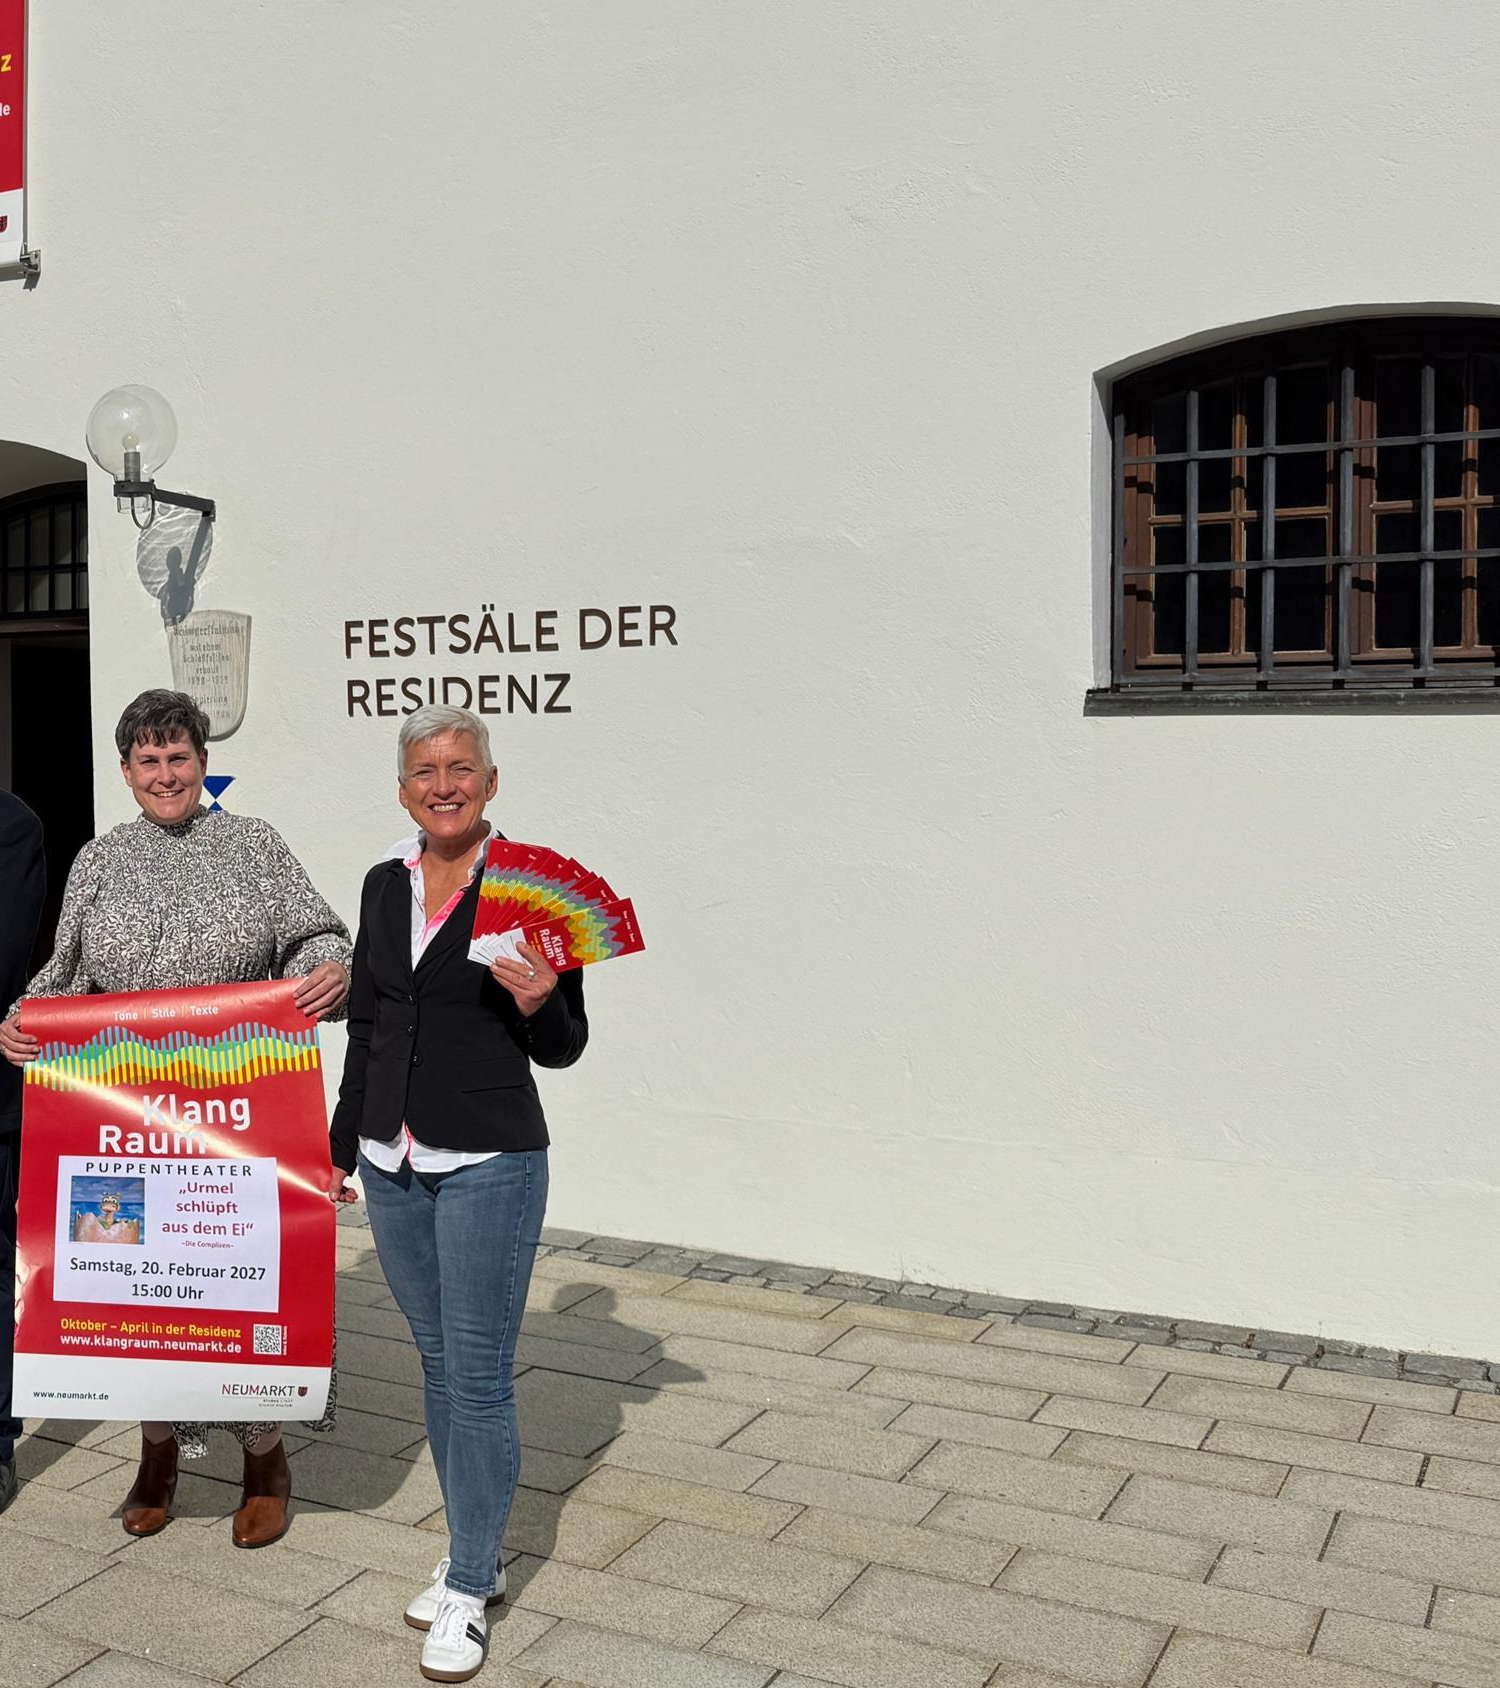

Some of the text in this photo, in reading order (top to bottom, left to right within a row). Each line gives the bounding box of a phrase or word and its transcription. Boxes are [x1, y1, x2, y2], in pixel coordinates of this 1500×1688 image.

[345, 604, 678, 659] FESTSÄLE DER
[347, 673, 572, 717] RESIDENZ
[540, 928, 555, 959] Raum
[551, 935, 567, 966] Klang
[113, 1005, 219, 1021] Töne Stile Texte
[142, 1094, 251, 1130] Klang
[99, 1125, 206, 1155] Raum
[86, 1162, 252, 1176] PUPPENTHEATER
[179, 1182, 234, 1196] „Urmel
[176, 1200, 238, 1215] schlüpft
[162, 1222, 188, 1233] aus
[193, 1221, 227, 1235] dem
[70, 1257, 266, 1281] Samstag, 20. Februar 2027
[131, 1284, 204, 1300] 15:00 Uhr
[60, 1319, 107, 1332] Oktober
[120, 1321, 149, 1336] April
[152, 1323, 162, 1334] in
[165, 1324, 186, 1335] der
[189, 1325, 241, 1338] Residenz
[60, 1334, 242, 1354] www.klangraum.neumarkt.de
[33, 1391, 109, 1401] www.neumarkt.de
[222, 1384, 295, 1397] NEUMARKT
